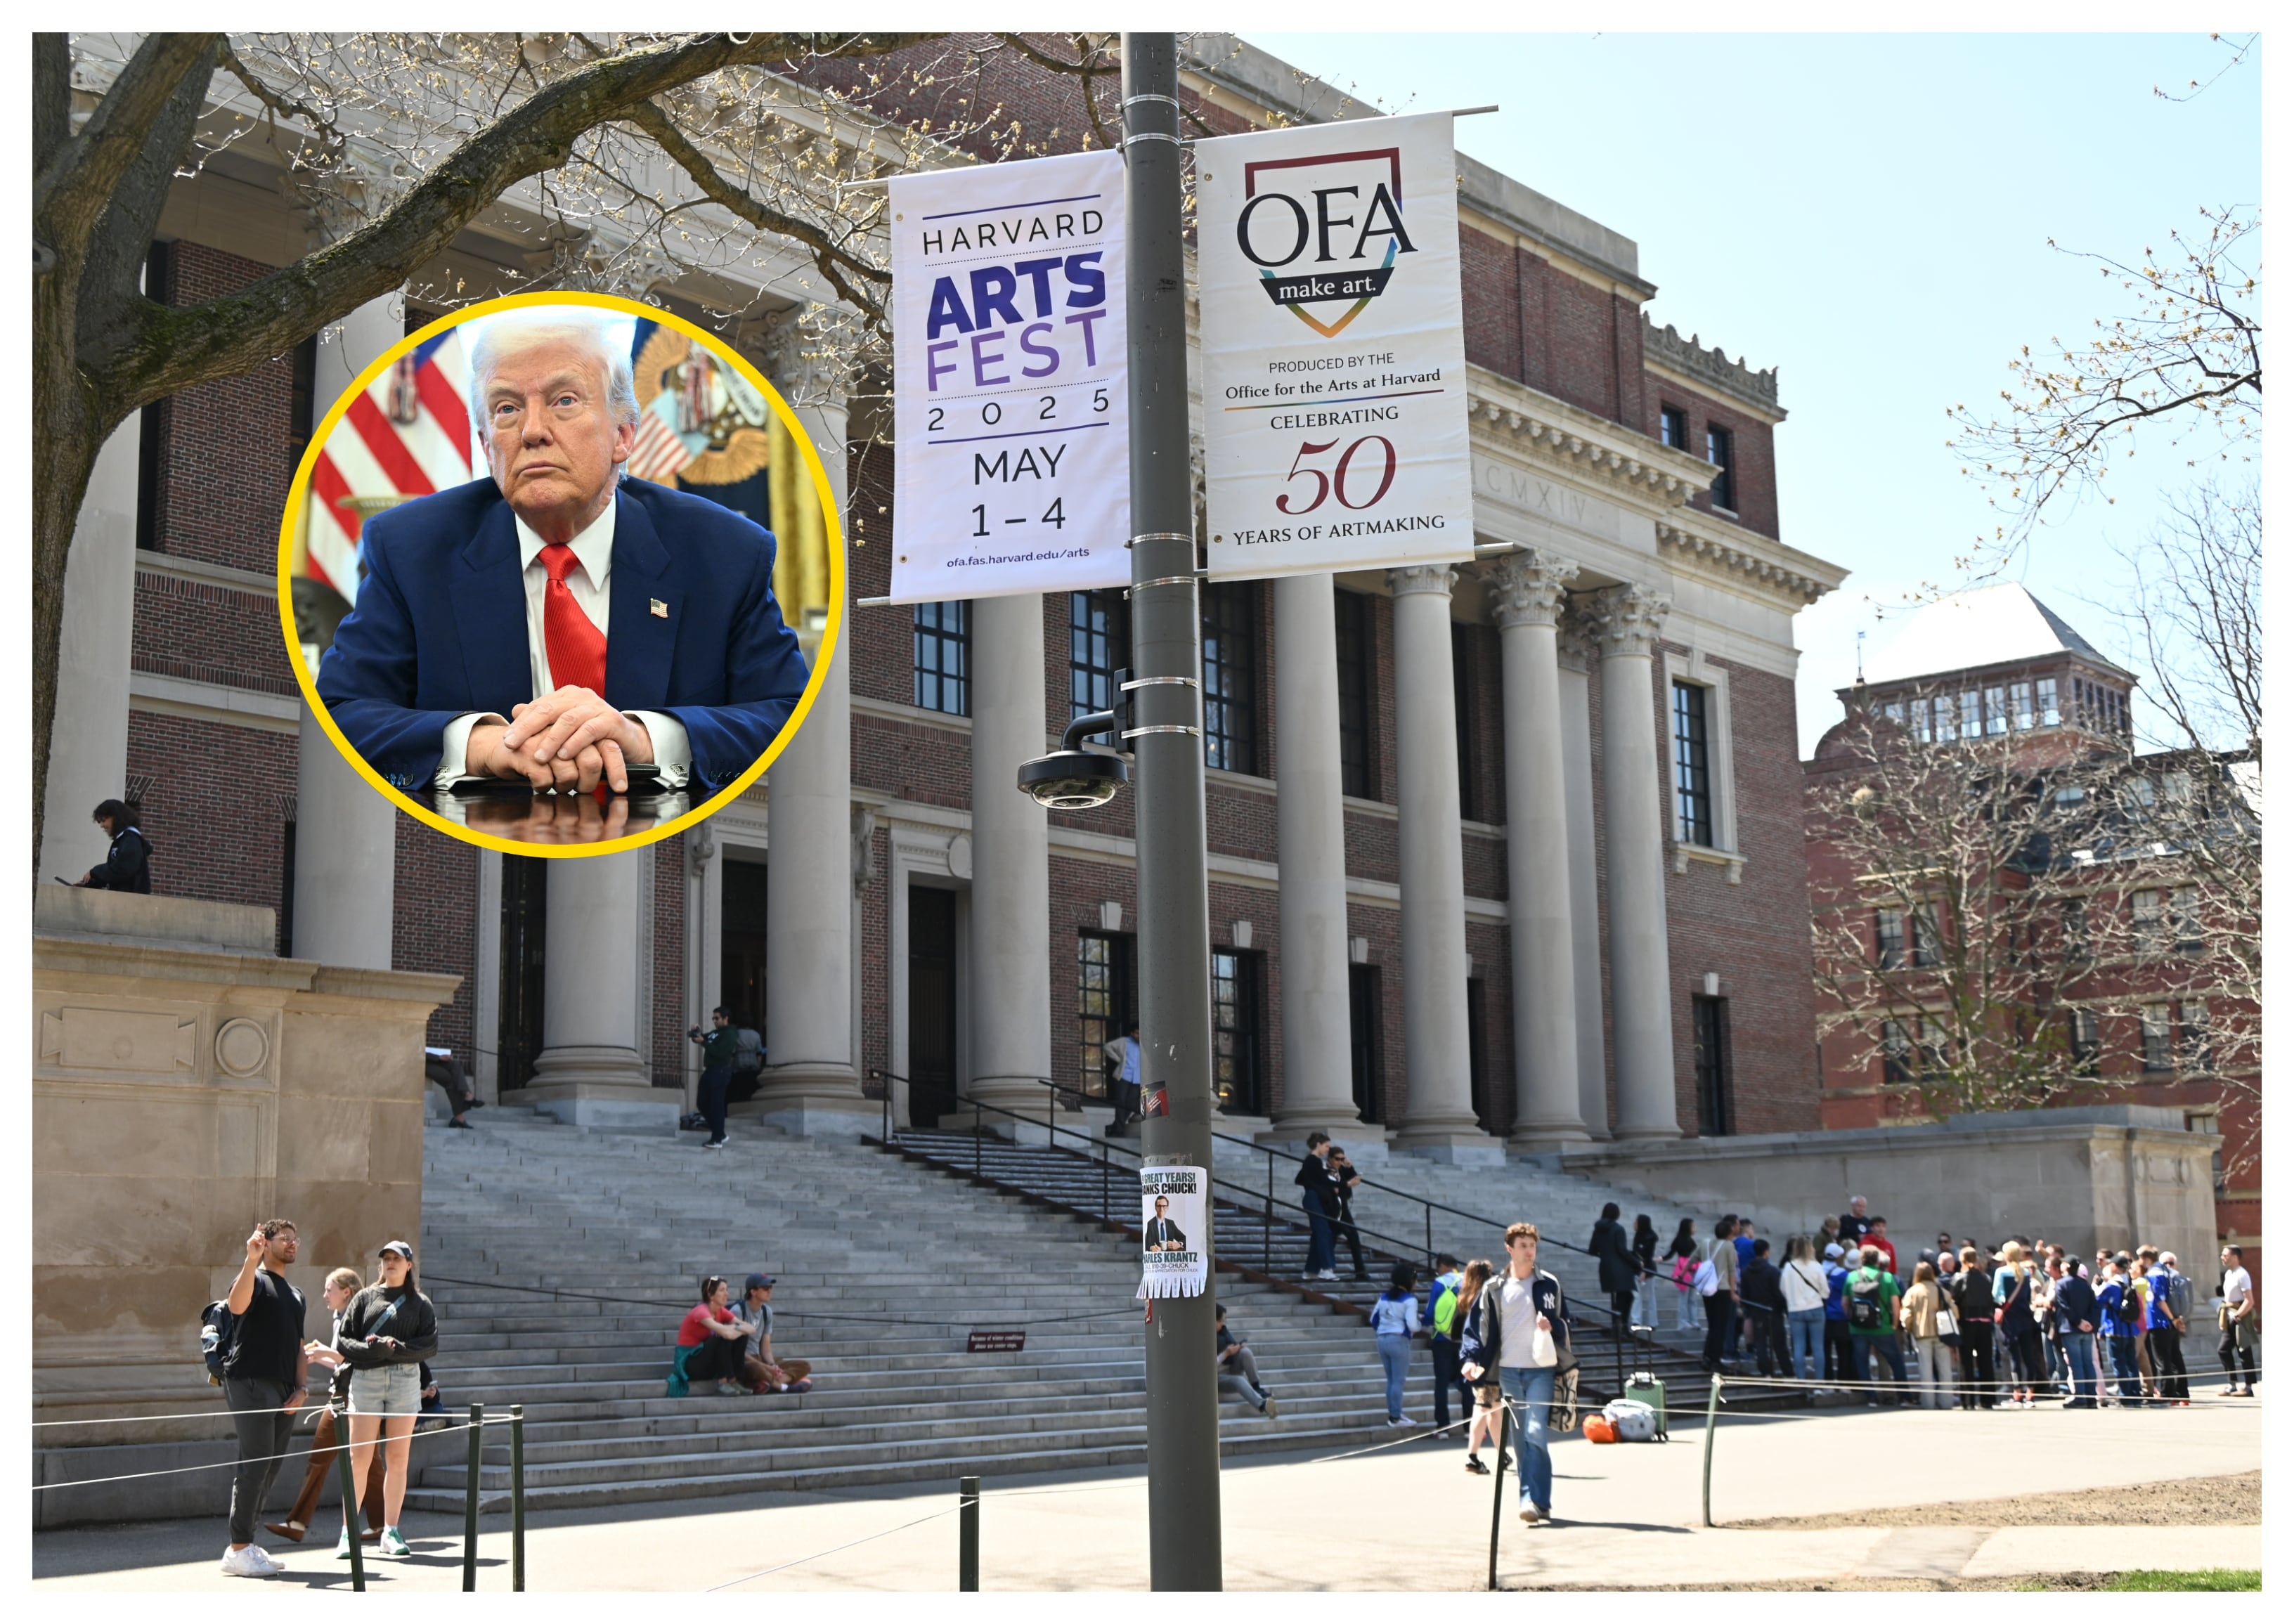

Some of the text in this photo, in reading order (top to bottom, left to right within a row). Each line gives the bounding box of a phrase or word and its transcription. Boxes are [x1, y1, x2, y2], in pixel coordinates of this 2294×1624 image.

[922, 209, 1104, 256] HARVARD
[1236, 182, 1419, 268] OFA
[926, 250, 1106, 341] ARTS
[1278, 275, 1377, 300] make art.
[926, 308, 1107, 392] FEST
[1269, 352, 1396, 374] PRODUCED BY THE
[1225, 368, 1441, 400] Office for the Arts at Harvard
[1270, 405, 1400, 430] CELEBRATING
[974, 443, 1067, 486] MAY
[1276, 434, 1397, 516] 50
[1471, 458, 1586, 521] CMXIV
[972, 503, 990, 537] 1
[1041, 496, 1066, 530] 4
[1233, 514, 1445, 546] YEARS OF ARTMAKING
[947, 547, 1090, 569] ofa.fas.harvard.edu/arts
[1144, 1172, 1164, 1184] GREAT
[1165, 1171, 1196, 1183] YEARS!
[1161, 1182, 1197, 1195] CHUCK!
[1164, 1252, 1198, 1263] KRANTZ
